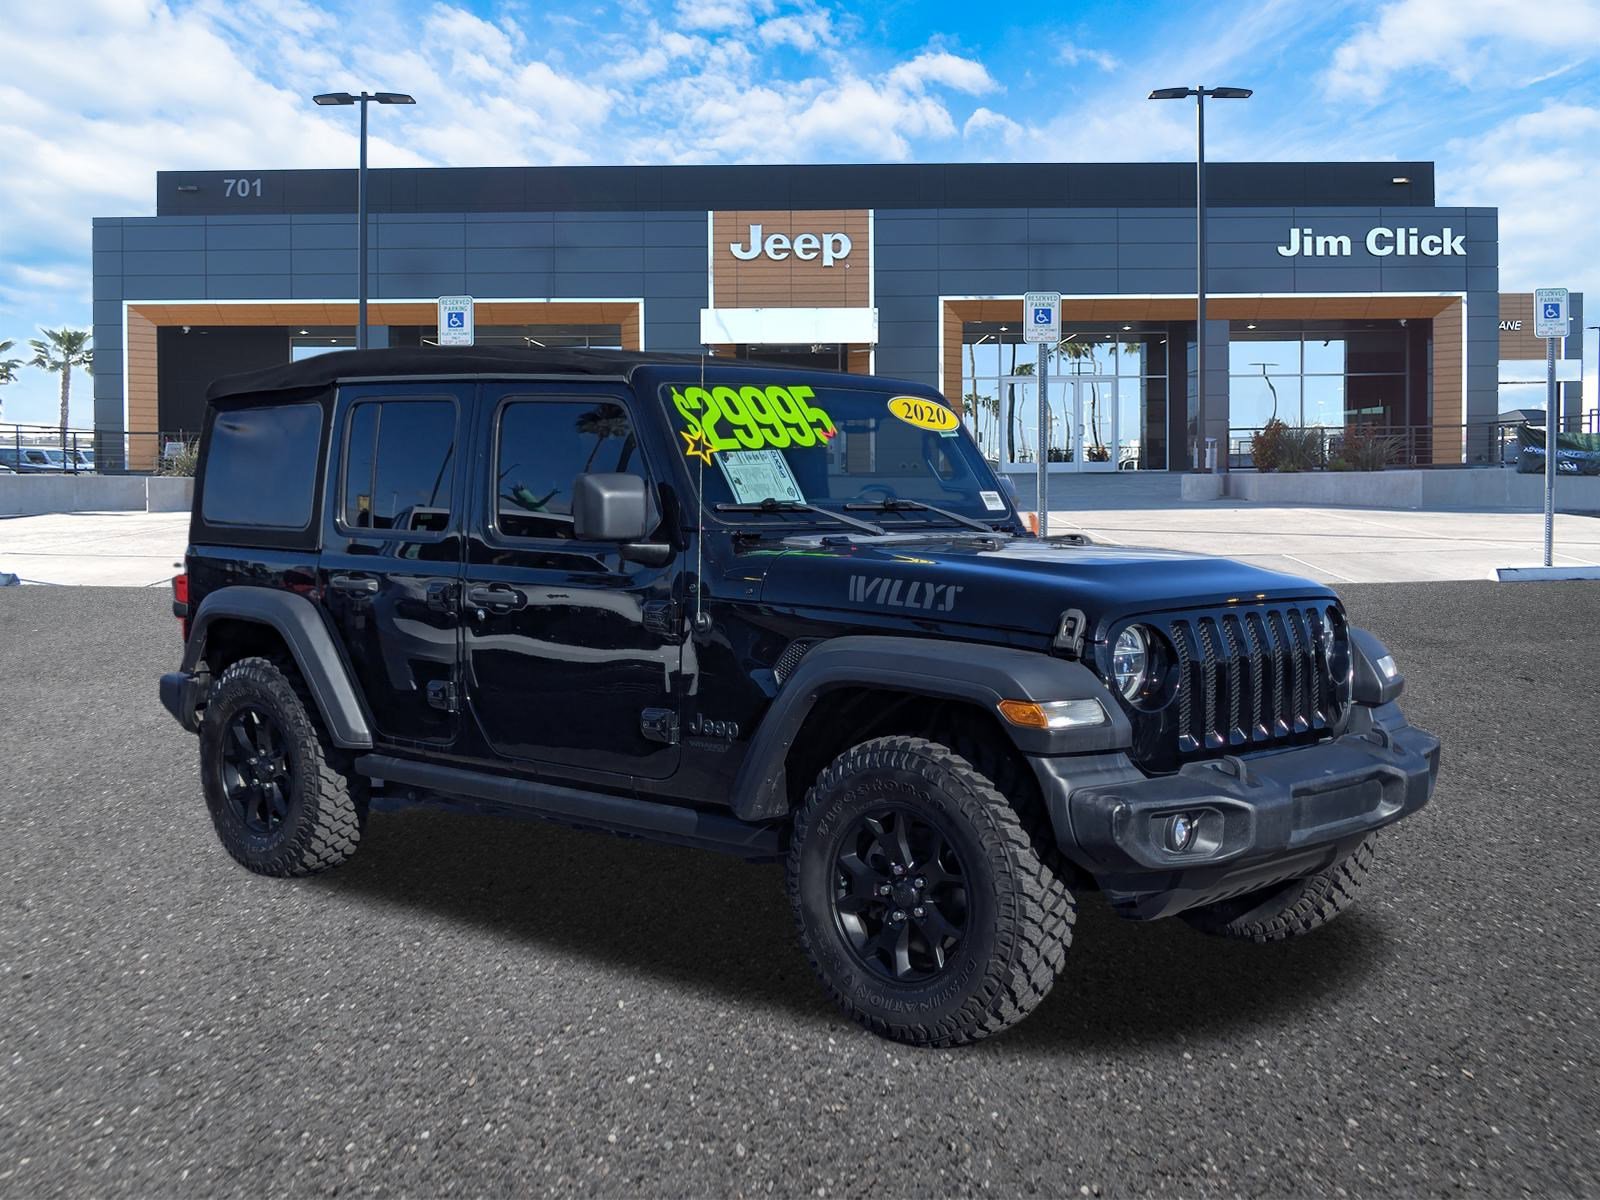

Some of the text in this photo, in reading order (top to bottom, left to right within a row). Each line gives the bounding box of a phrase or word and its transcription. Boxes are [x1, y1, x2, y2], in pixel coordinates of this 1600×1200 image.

[223, 178, 262, 197] 701
[729, 224, 852, 267] Jeep
[1277, 226, 1467, 257] Jim Click
[671, 386, 837, 450] $29995
[902, 402, 946, 425] 2020
[848, 575, 964, 612] WILLYS
[689, 712, 739, 745] Jeep
